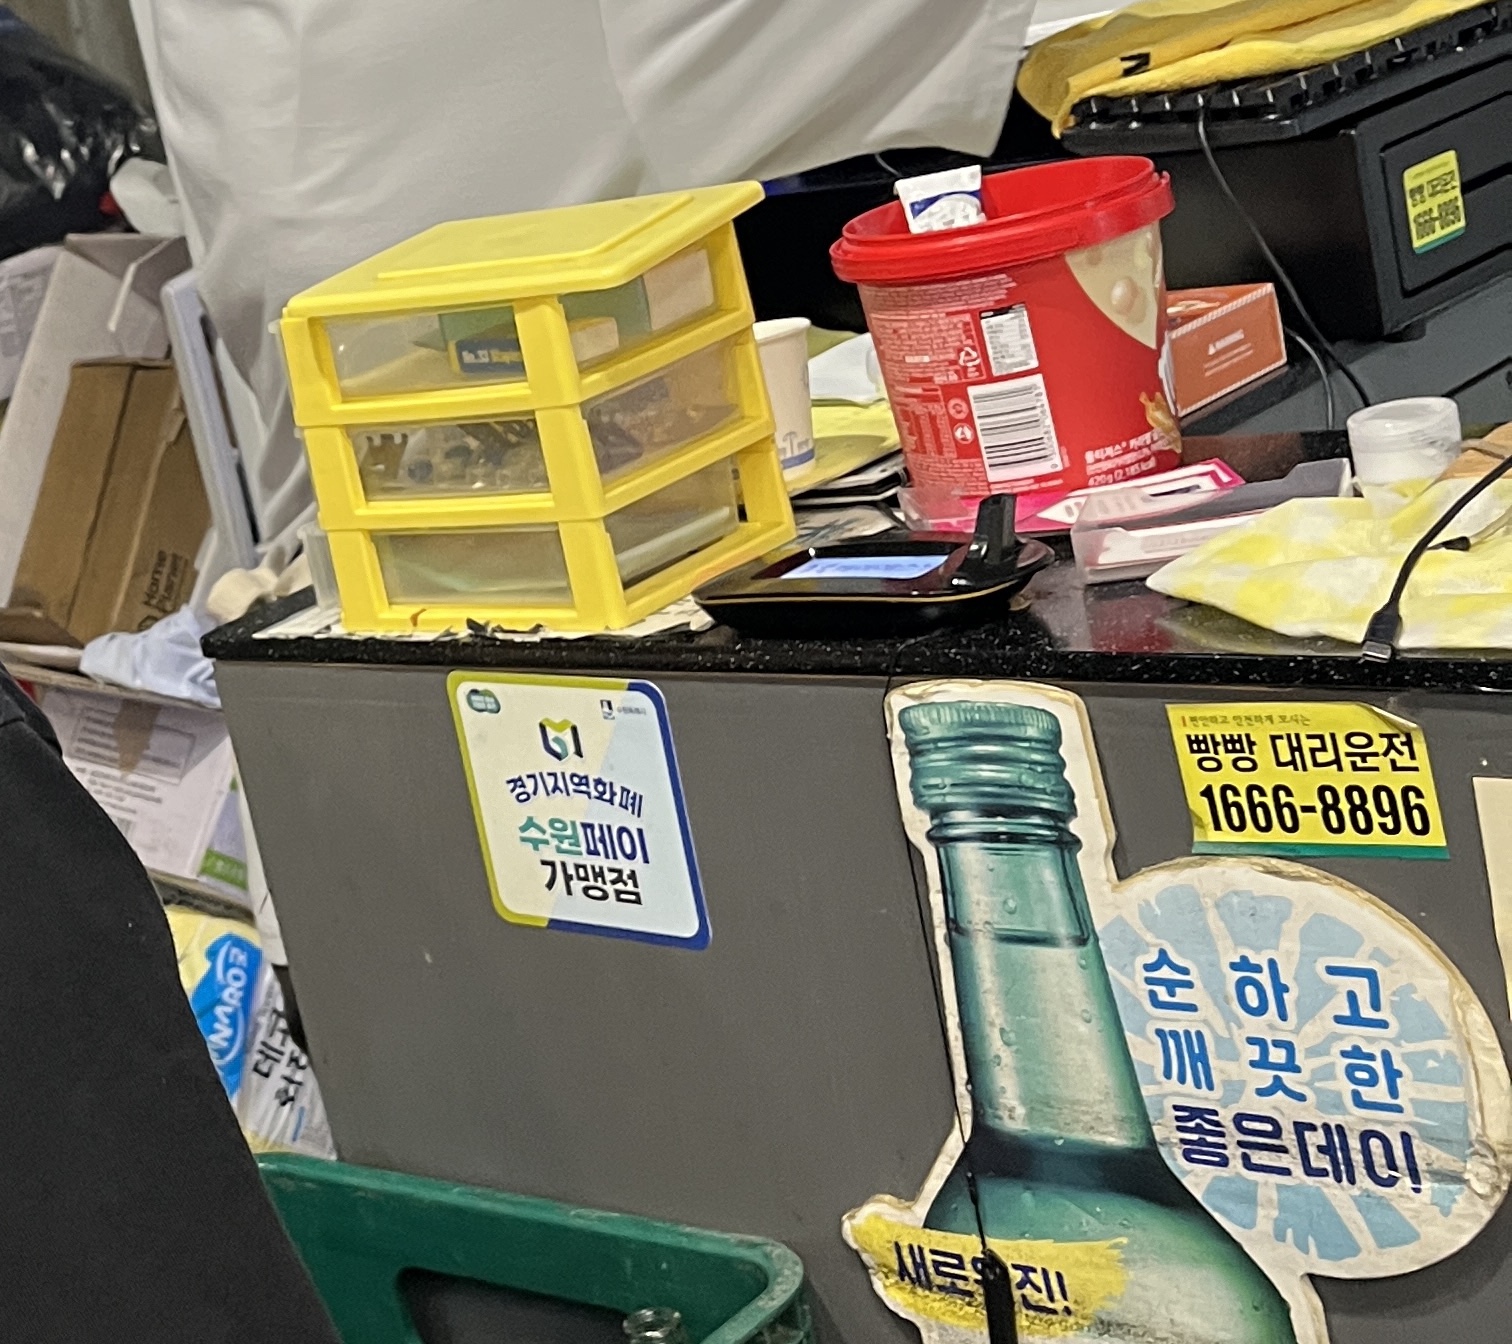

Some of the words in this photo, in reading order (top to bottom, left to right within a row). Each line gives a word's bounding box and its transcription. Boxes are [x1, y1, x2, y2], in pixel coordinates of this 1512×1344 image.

[1185, 732, 1258, 773] 빵빵
[1269, 731, 1420, 773] 대리운전
[505, 771, 644, 819] 경기지역화폐
[1199, 783, 1431, 837] 1666-8896
[518, 815, 651, 865] 수원페이
[540, 859, 644, 906] 가맹점
[1142, 947, 1391, 1031] 순하고
[1154, 1027, 1405, 1114] 깨끗한
[1171, 1103, 1422, 1194] 좋은데이
